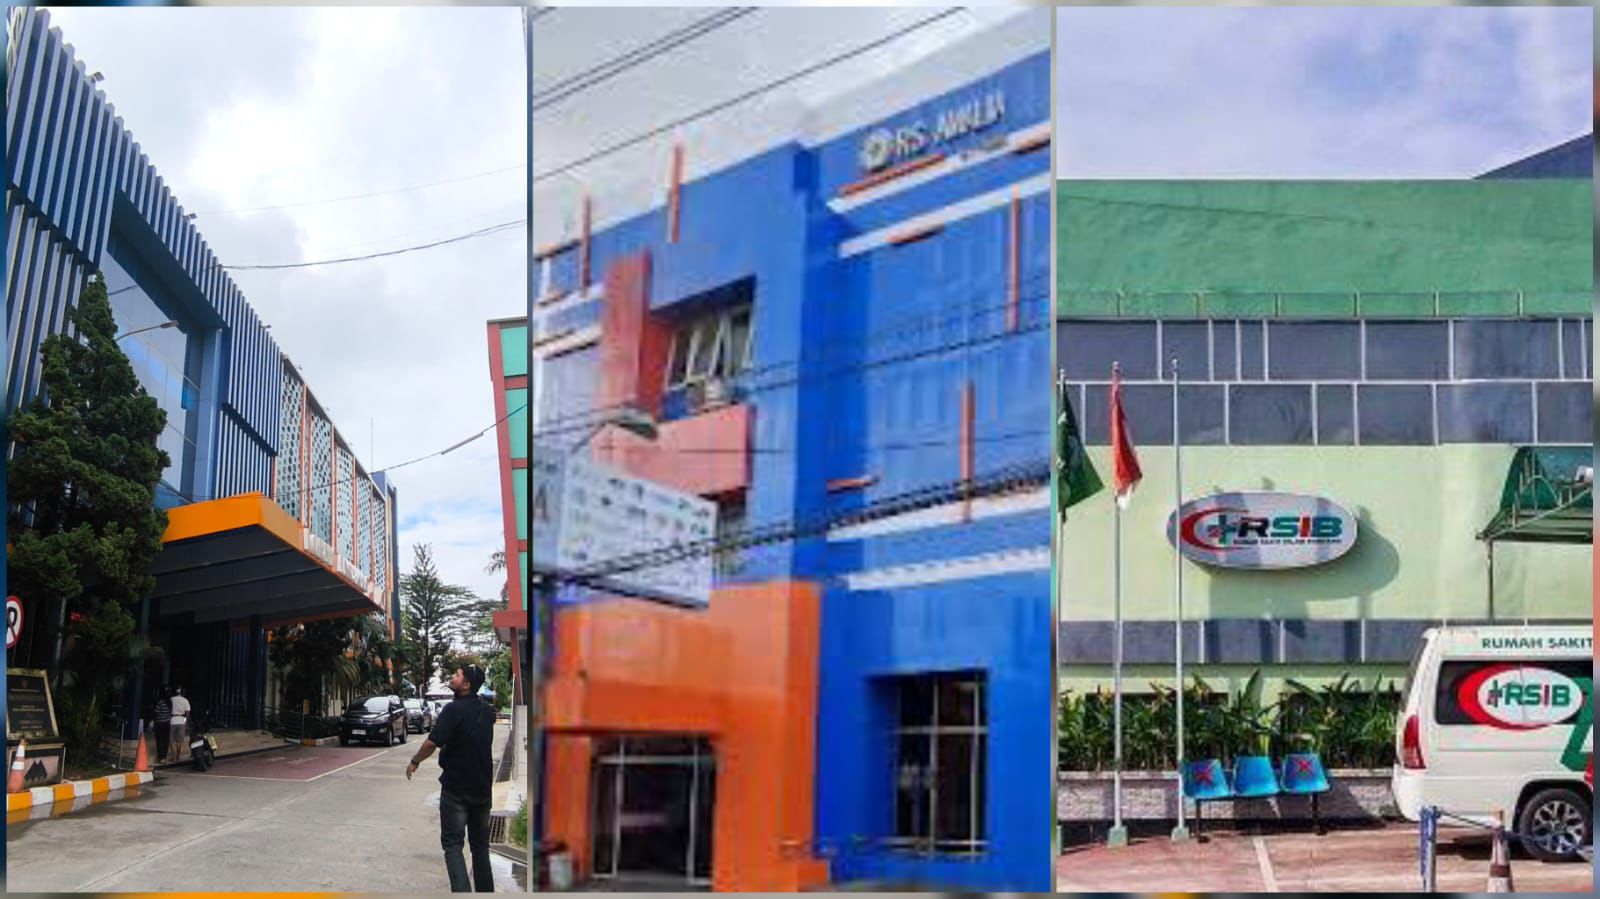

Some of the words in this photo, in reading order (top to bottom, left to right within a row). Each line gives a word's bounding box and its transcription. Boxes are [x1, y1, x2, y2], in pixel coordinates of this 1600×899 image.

[1238, 516, 1343, 538] RSIB
[1482, 637, 1542, 649] RUMAH
[1548, 637, 1593, 649] SAKIT
[1504, 683, 1571, 707] RSIB
